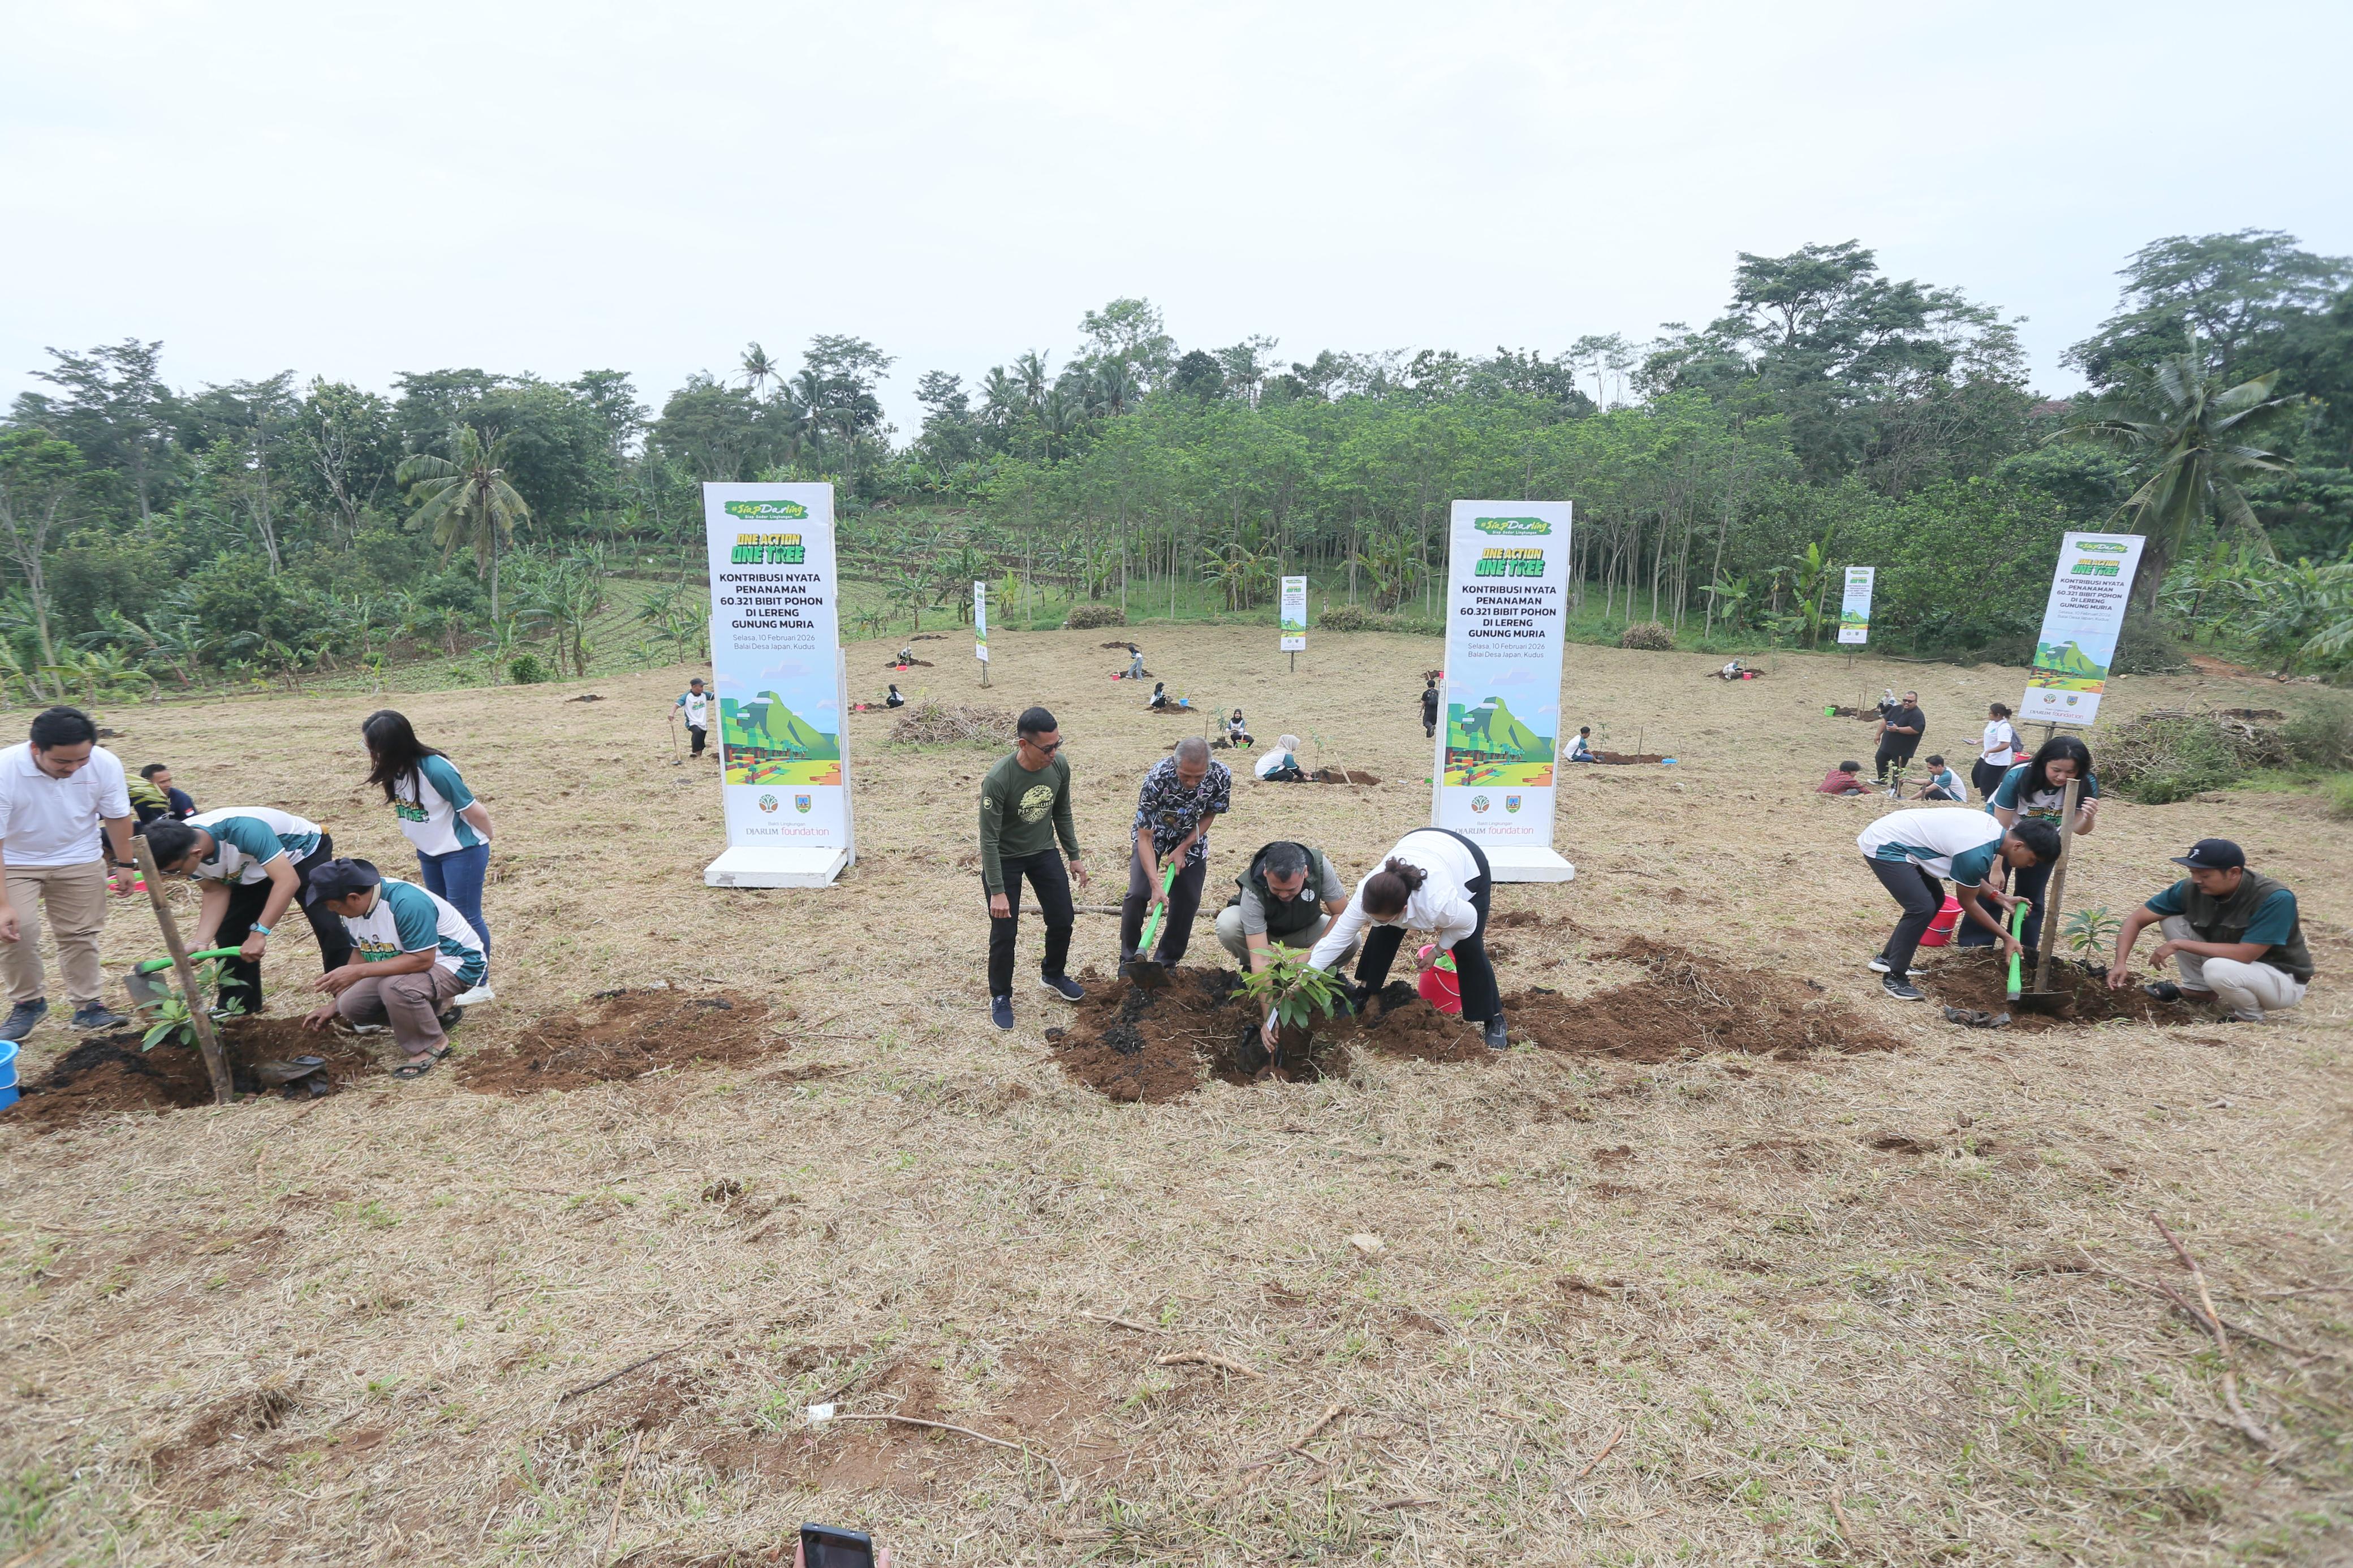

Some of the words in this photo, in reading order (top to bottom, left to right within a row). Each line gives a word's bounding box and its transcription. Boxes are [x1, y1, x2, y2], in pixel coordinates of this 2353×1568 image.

[732, 504, 803, 516] #SiapDarling
[1481, 520, 1548, 532] #SiapDarling
[736, 533, 760, 546] ONE
[760, 533, 801, 546] ACTION
[731, 546, 764, 564] ONE
[765, 546, 805, 564] TREE
[1482, 547, 1504, 559] ONE
[1503, 548, 1544, 560] ACTION
[1474, 559, 1507, 577] ONE
[1508, 560, 1545, 577] TREE
[2071, 564, 2094, 575] ONE
[2093, 565, 2119, 576] TREE
[770, 643, 792, 651] Japan,
[781, 827, 829, 836] foundation
[1489, 826, 1533, 835] foundation
